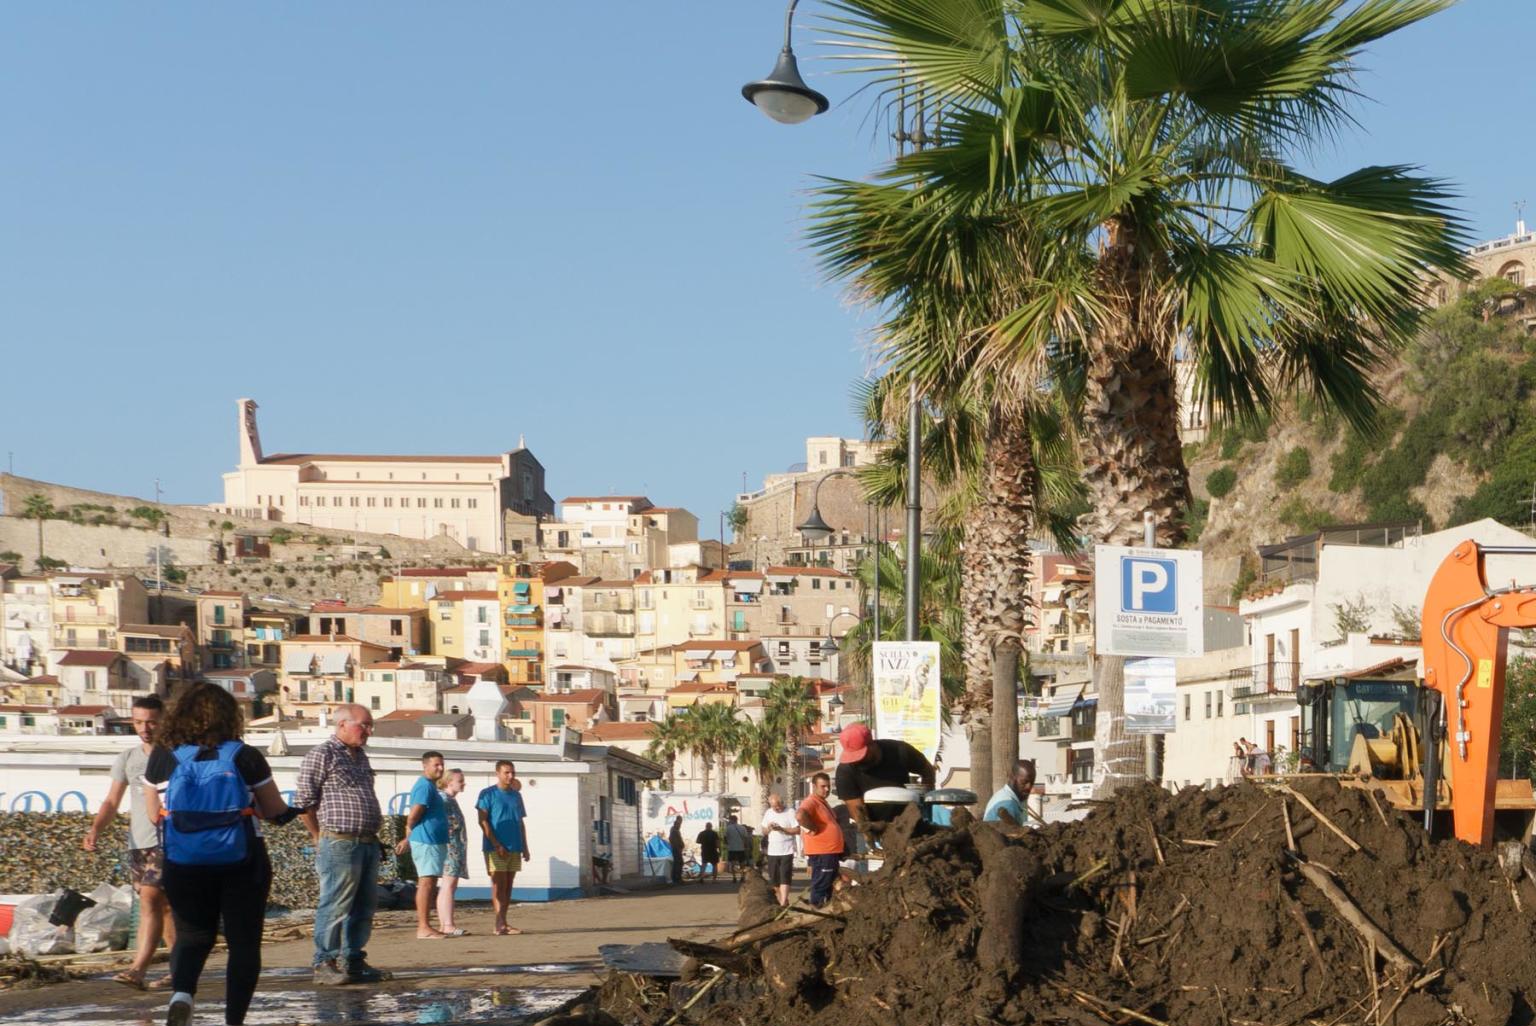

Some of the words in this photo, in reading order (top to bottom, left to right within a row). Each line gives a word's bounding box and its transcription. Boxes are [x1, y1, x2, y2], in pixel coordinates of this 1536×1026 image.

[1131, 560, 1169, 610] P
[1117, 615, 1137, 624] SOSTA
[1143, 616, 1183, 625] PAGAMENTO
